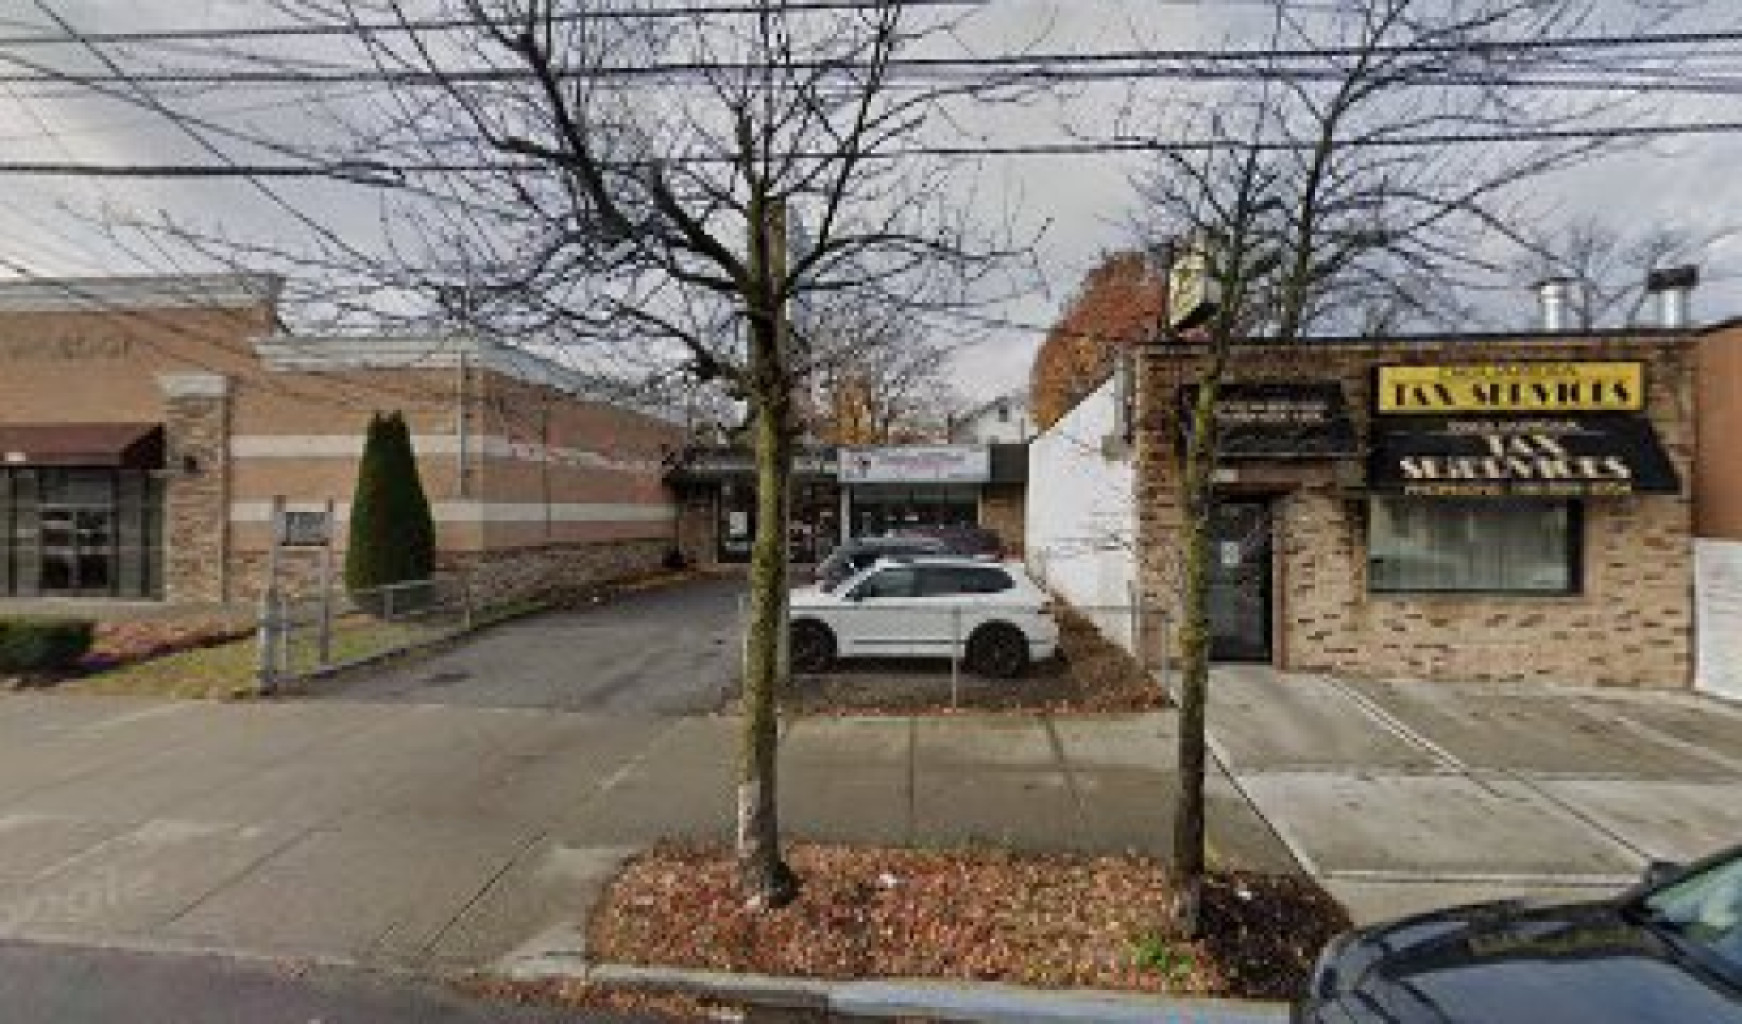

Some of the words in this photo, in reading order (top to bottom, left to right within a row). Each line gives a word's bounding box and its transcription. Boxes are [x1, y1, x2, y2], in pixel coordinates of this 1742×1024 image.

[1392, 382, 1456, 406] TAX
[1470, 380, 1632, 405] SERVICES
[1484, 434, 1566, 457] TAX
